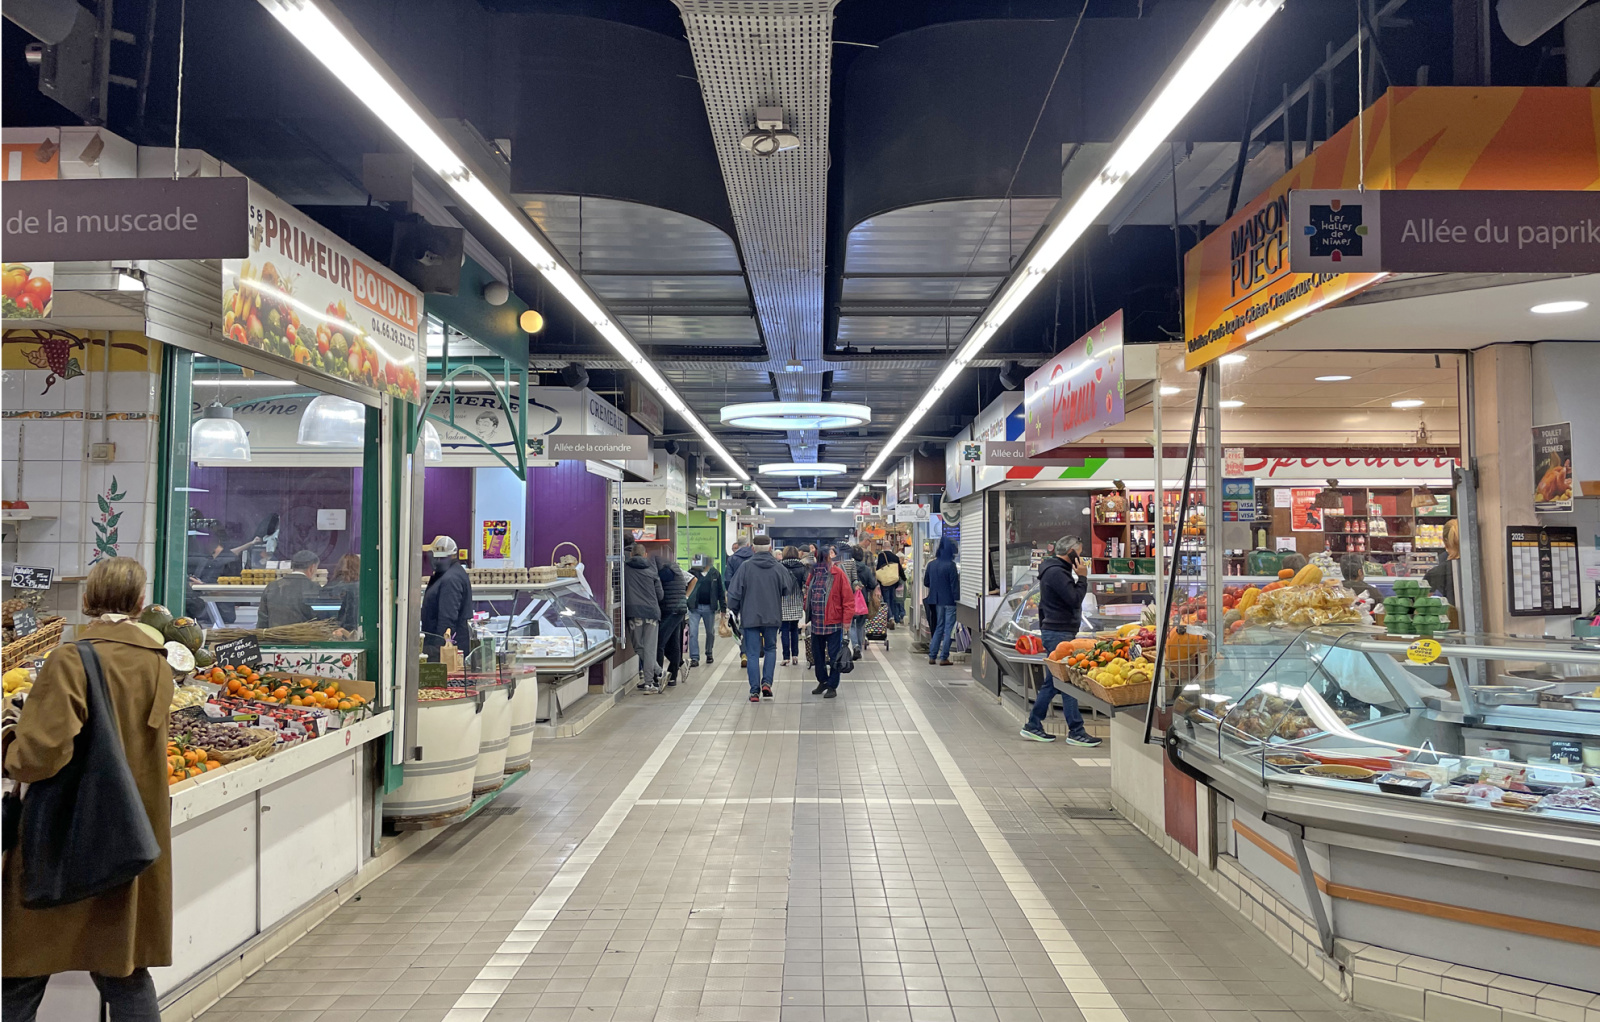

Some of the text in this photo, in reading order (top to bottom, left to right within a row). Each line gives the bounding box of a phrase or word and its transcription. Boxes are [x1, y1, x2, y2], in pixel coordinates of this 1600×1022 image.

[6, 206, 198, 234] de la muscade
[1231, 190, 1290, 260] MAISON
[1401, 218, 1467, 243] Allée
[1474, 218, 1509, 243] du
[265, 209, 352, 292] PRIMEUR
[1231, 225, 1290, 298] PUECH
[355, 265, 414, 326] BOUDAL
[1050, 364, 1098, 439] Primeur
[1541, 429, 1562, 437] POULET
[554, 443, 632, 452] Allée de la coriandre
[991, 450, 1024, 458] Allée du
[1541, 444, 1563, 453] FERMIER
